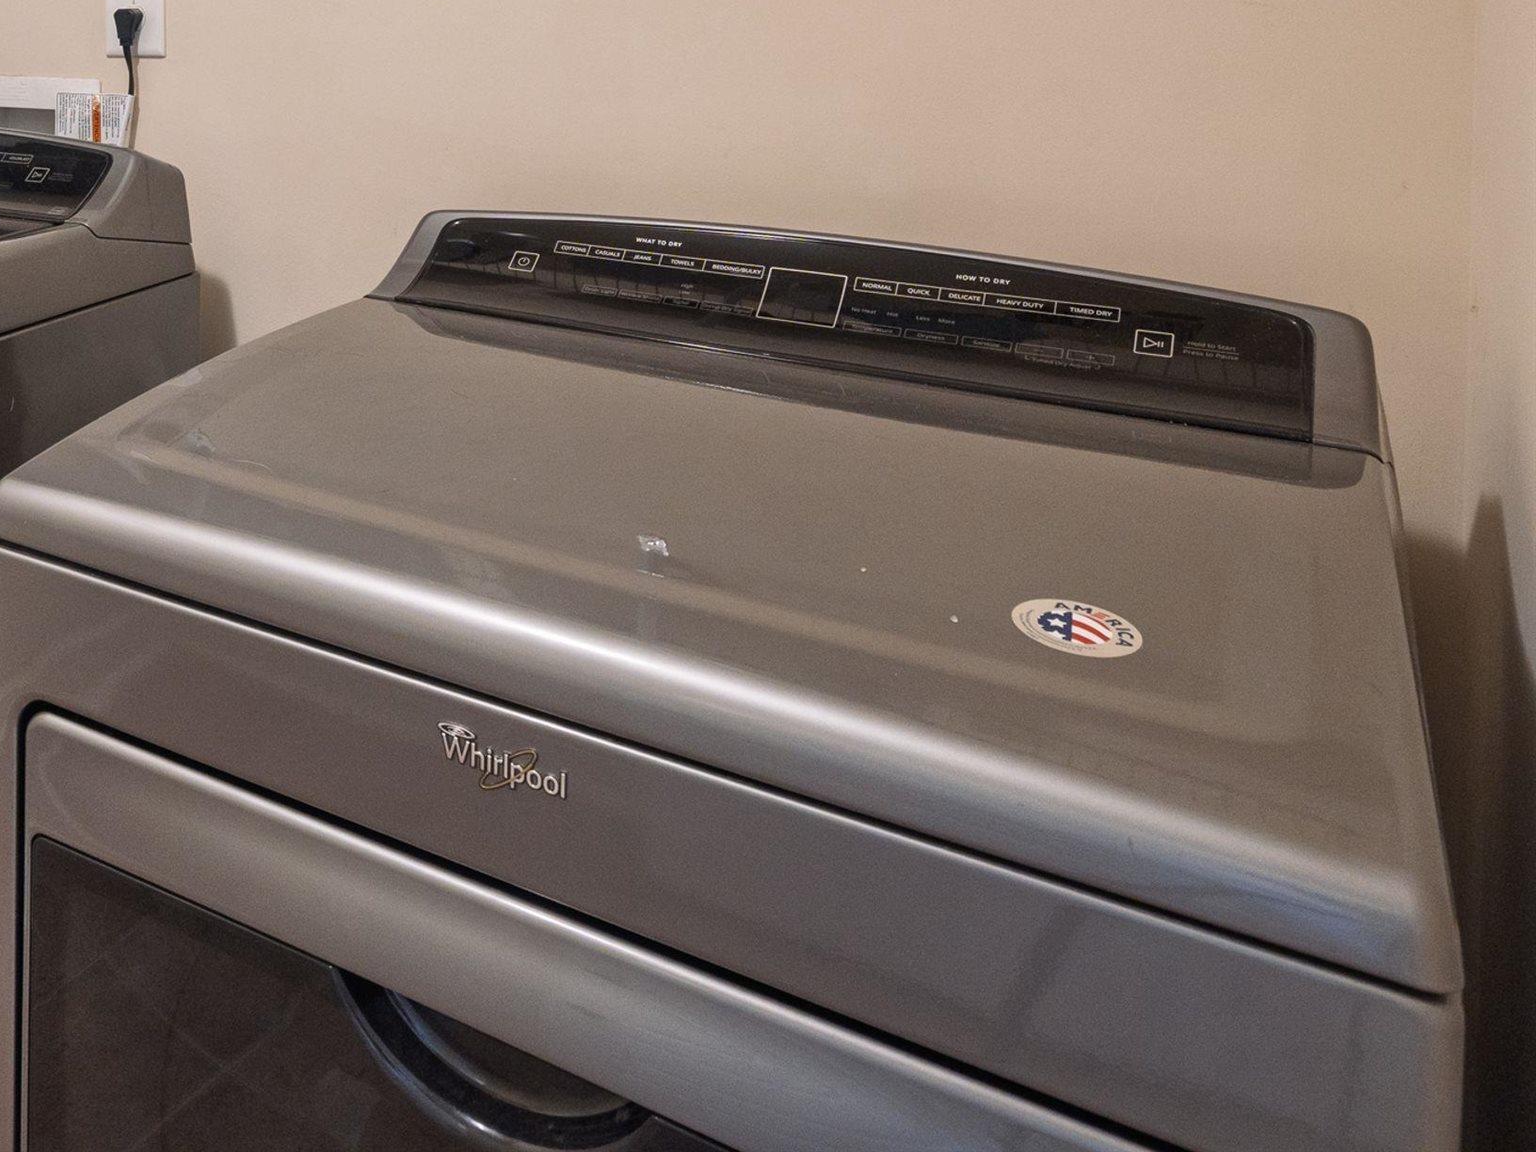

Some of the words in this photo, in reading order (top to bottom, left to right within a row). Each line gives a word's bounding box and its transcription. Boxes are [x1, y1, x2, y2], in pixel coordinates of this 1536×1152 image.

[636, 237, 655, 246] WHAT
[657, 239, 666, 247] TO
[668, 240, 683, 248] DRY
[595, 249, 621, 258] CASUALS
[633, 253, 652, 262] JEANS
[670, 258, 695, 267] TOWELS
[956, 273, 977, 283] HOW
[979, 276, 991, 284] TO
[993, 278, 1011, 286] DRY
[862, 282, 893, 292] NORMAL
[907, 287, 931, 297] QUICK
[948, 292, 981, 303] DELICATE
[996, 298, 1021, 308] HEAVY
[1022, 301, 1044, 310] DUTY
[1069, 306, 1095, 316] TIMED
[1096, 309, 1113, 318] DRY
[1055, 602, 1135, 648] AMERICA
[440, 731, 567, 800] Whirlpool
